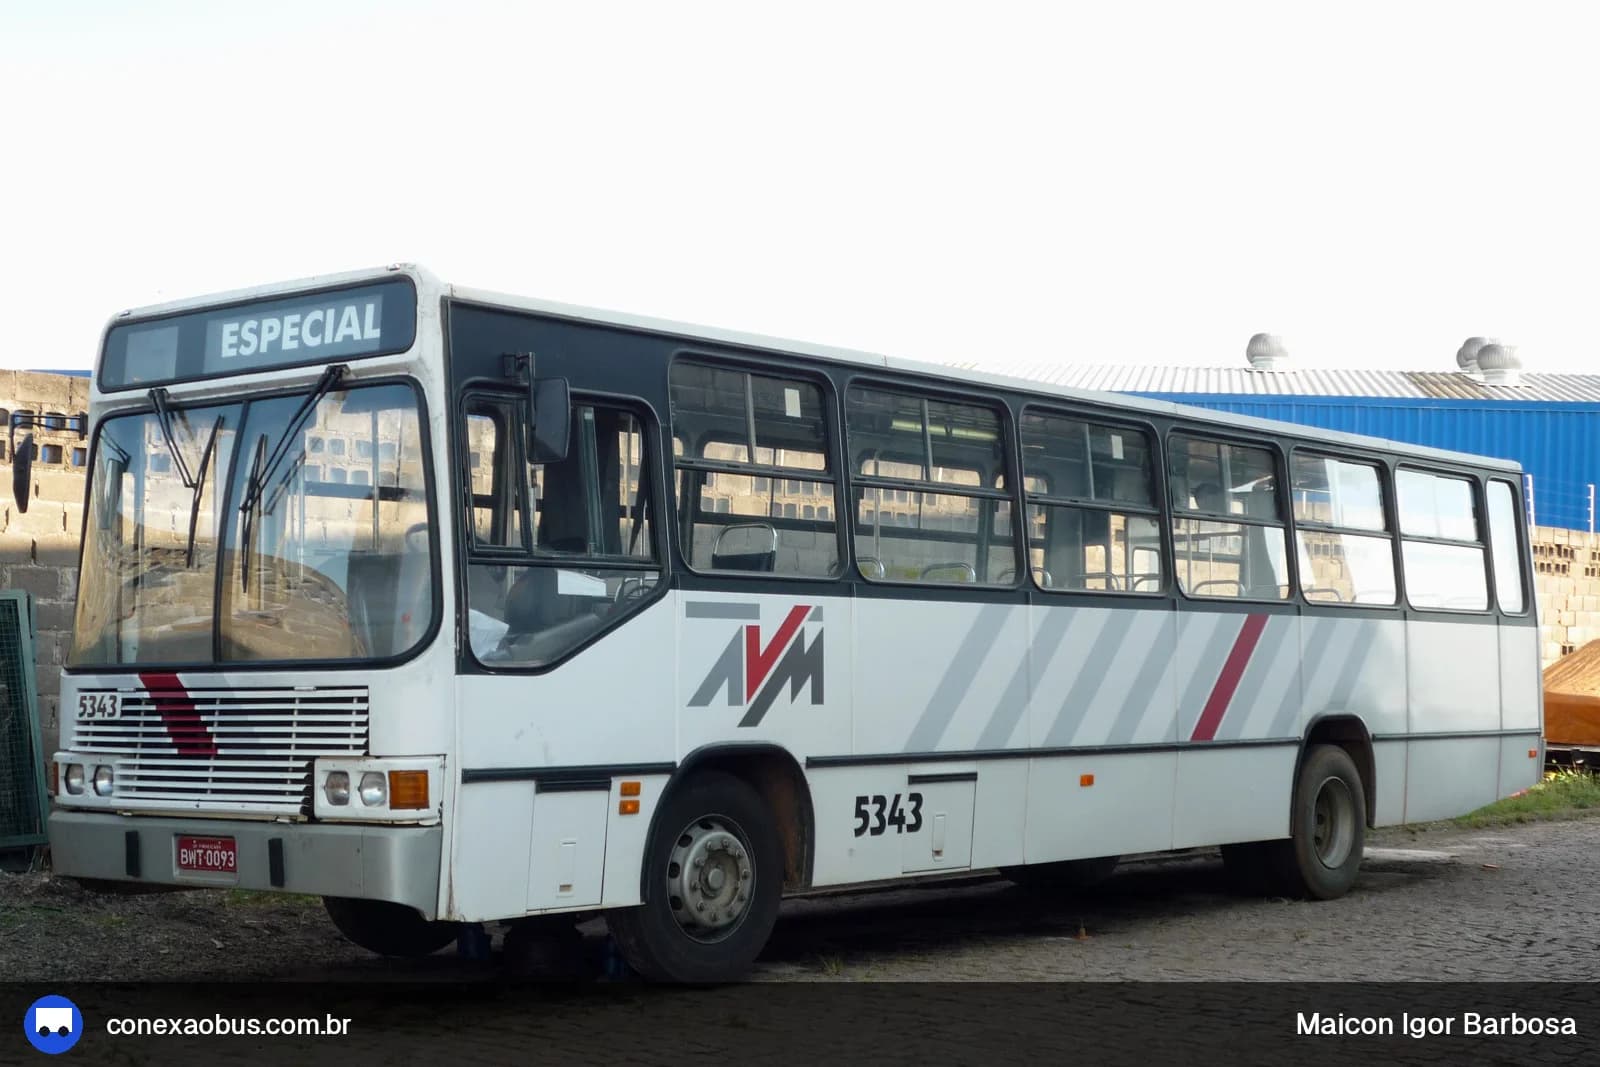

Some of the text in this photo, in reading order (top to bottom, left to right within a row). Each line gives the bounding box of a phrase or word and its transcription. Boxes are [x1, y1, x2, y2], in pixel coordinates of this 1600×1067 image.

[221, 303, 381, 358] ESPECIAL
[78, 695, 118, 718] 5343
[854, 792, 923, 838] 5343
